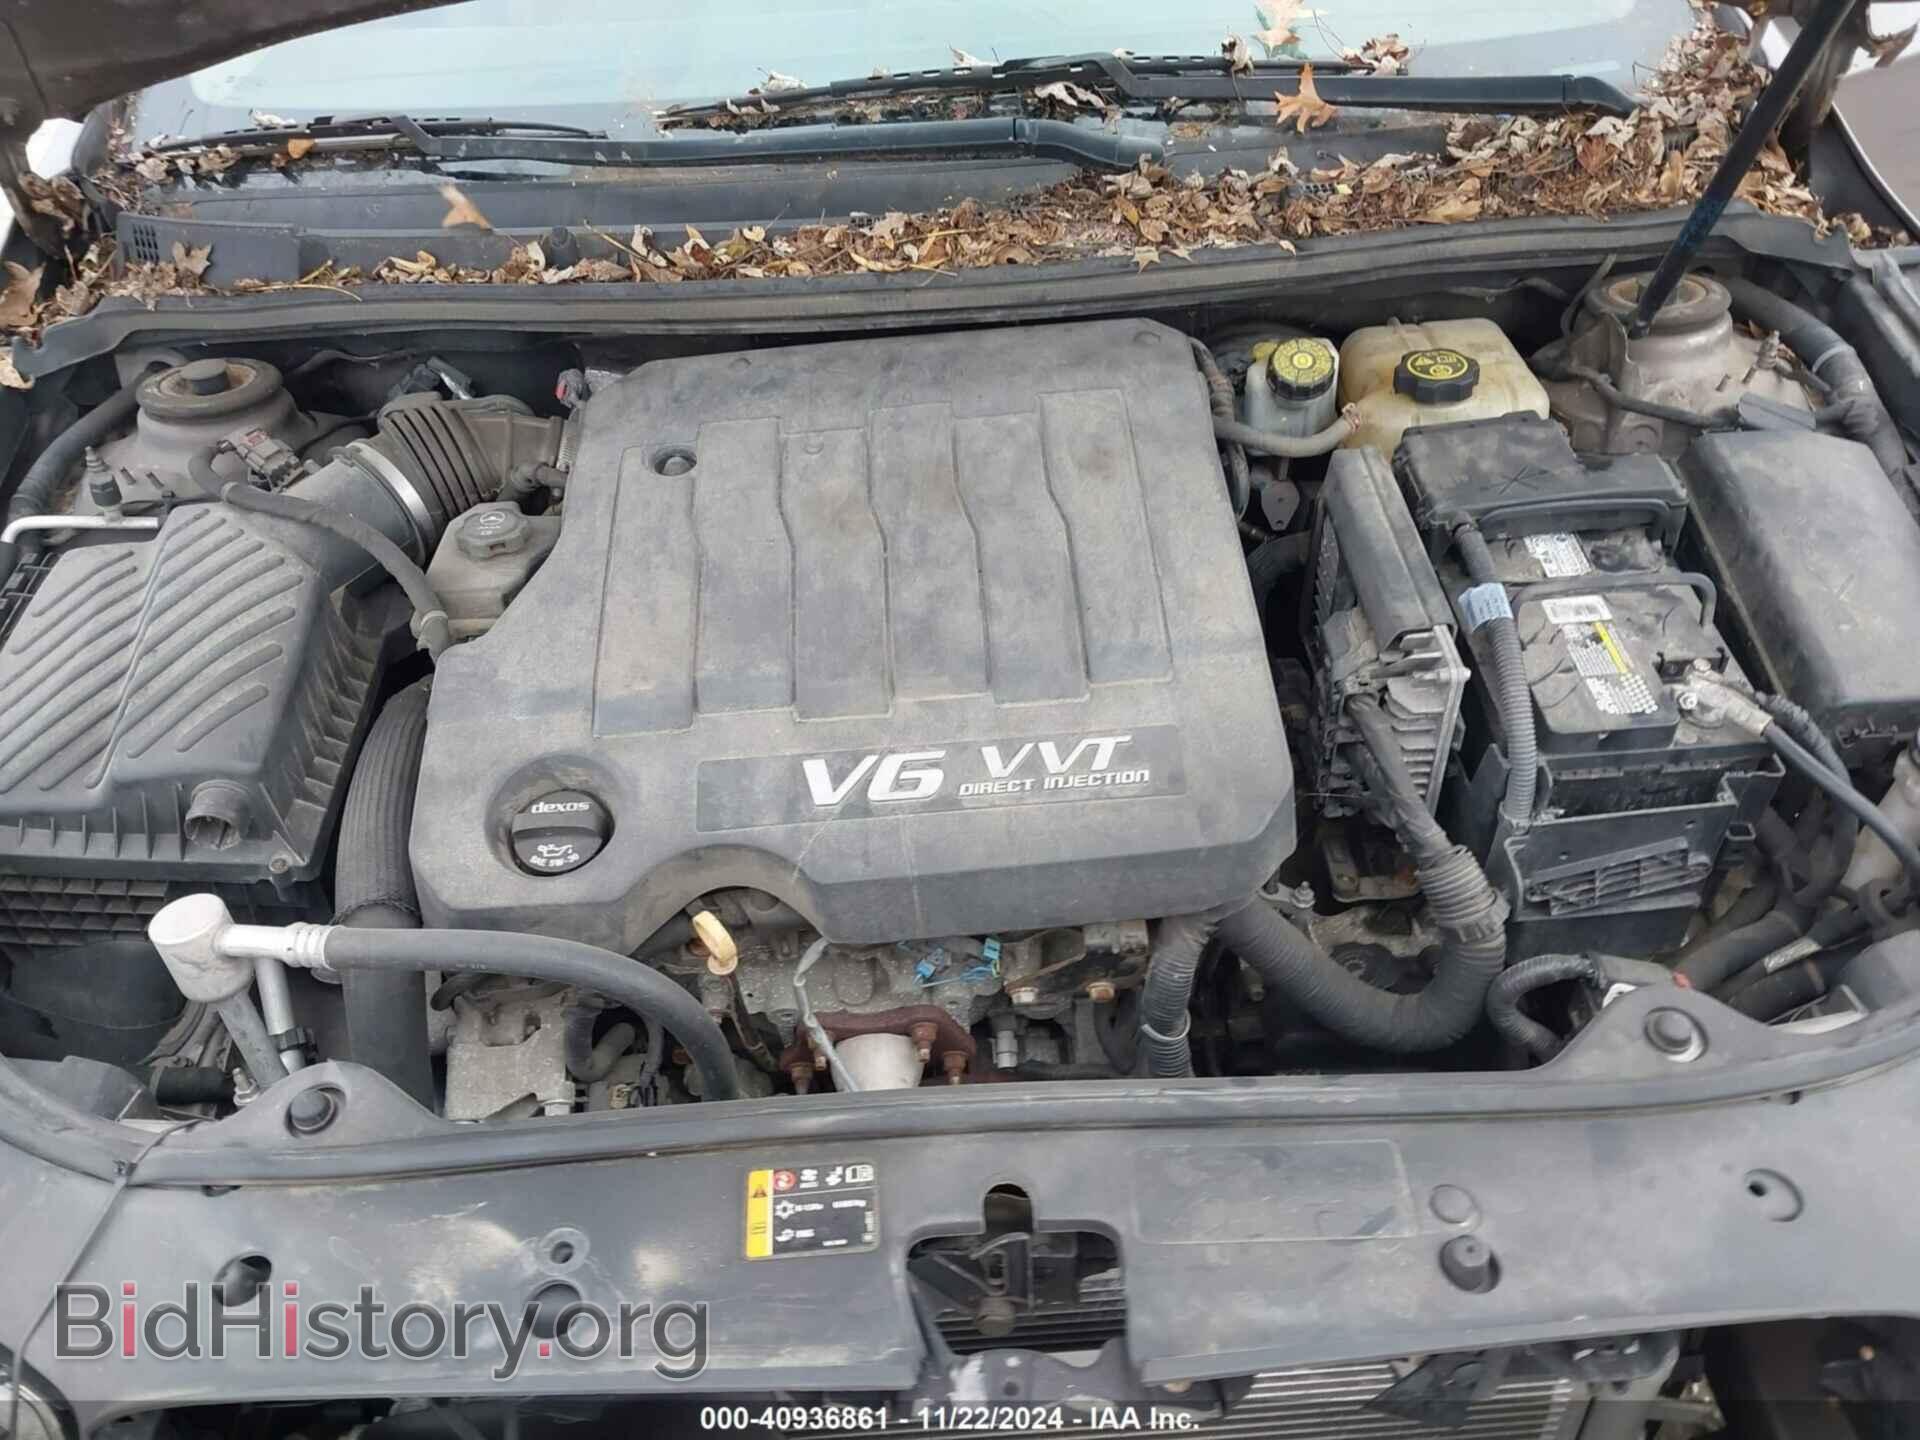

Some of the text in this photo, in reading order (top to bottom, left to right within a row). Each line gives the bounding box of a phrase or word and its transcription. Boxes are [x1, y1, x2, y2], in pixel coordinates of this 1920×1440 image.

[802, 735, 1133, 806] V6 VVT
[958, 769, 1150, 797] DIRECT INJECTION
[531, 801, 592, 814] dexos
